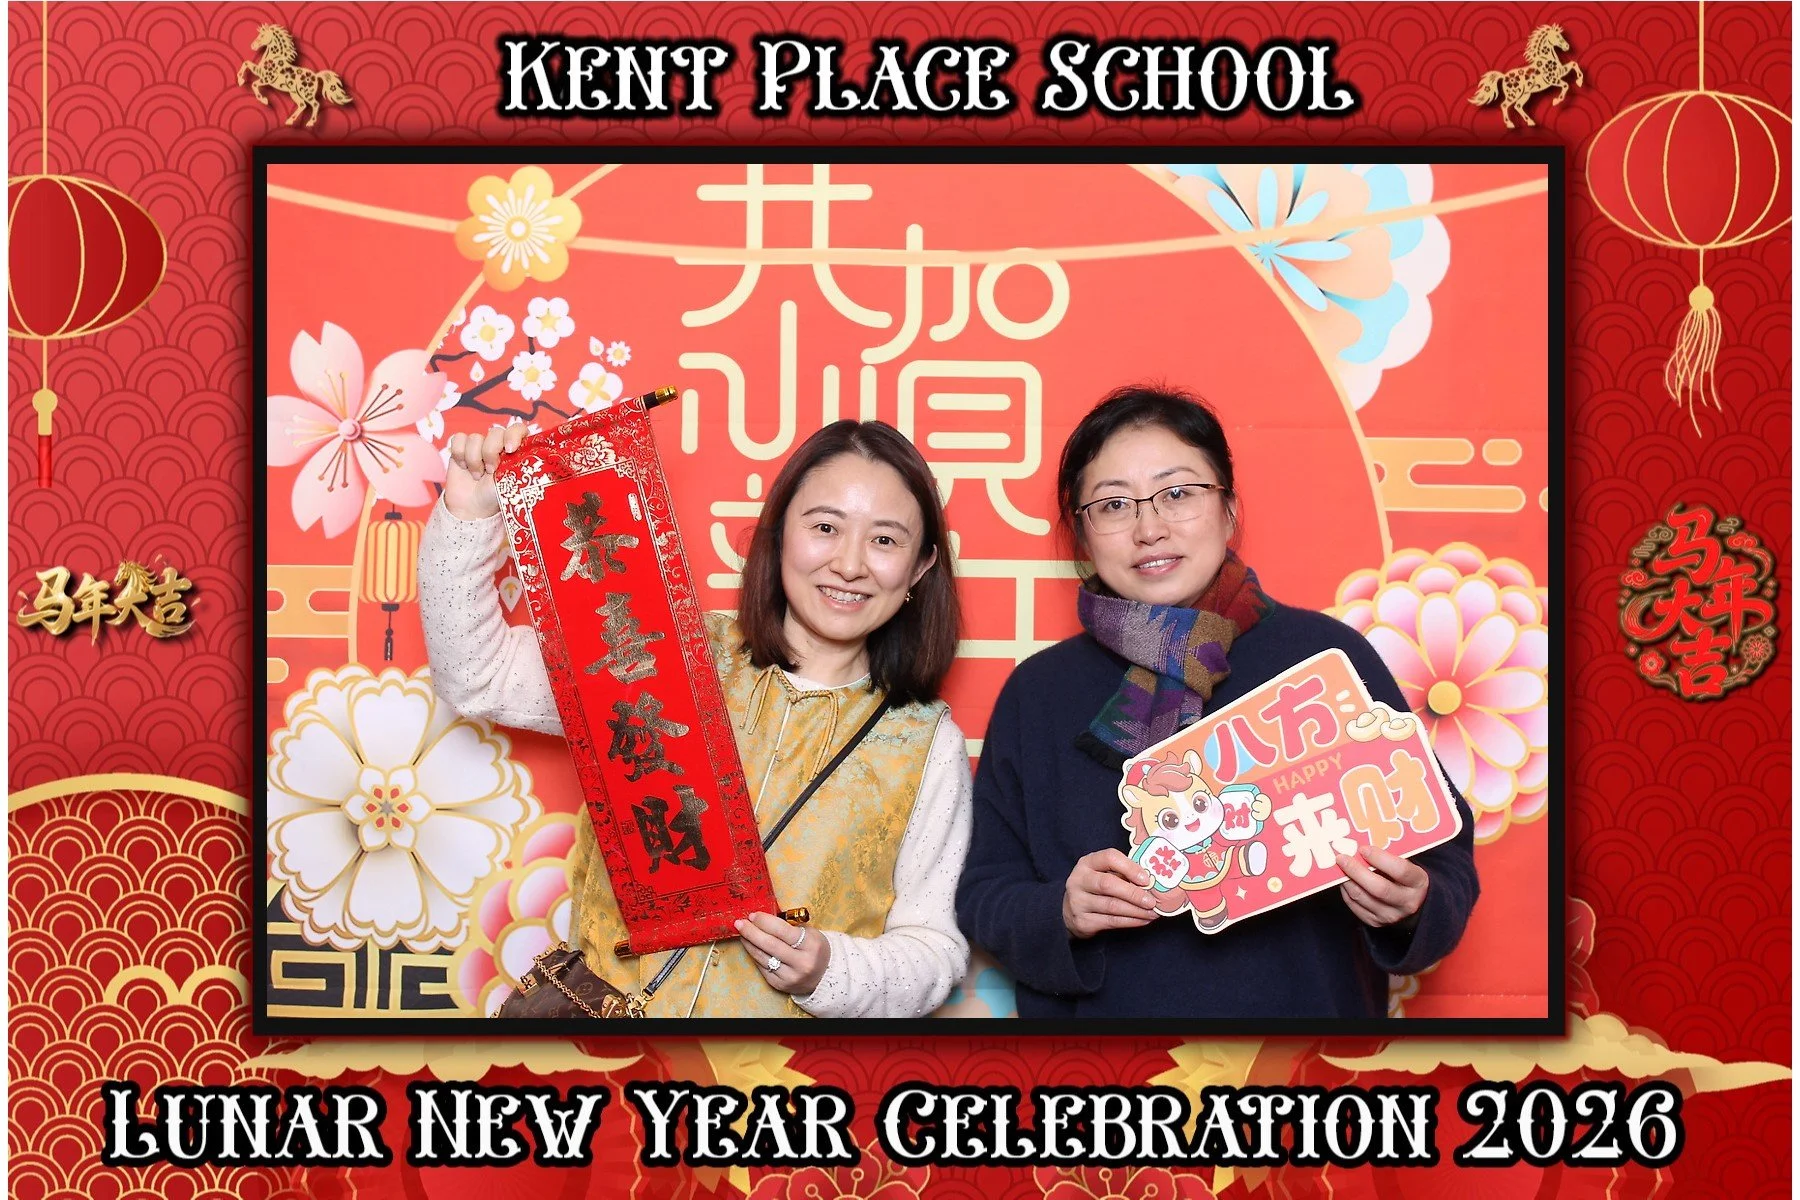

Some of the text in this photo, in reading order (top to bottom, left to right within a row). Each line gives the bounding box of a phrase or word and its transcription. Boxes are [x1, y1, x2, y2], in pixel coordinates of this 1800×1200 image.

[559, 491, 710, 874] 恭喜發財
[1212, 673, 1341, 785] 八方
[1272, 752, 1343, 795] HAPPY
[1272, 748, 1441, 878] 来财
